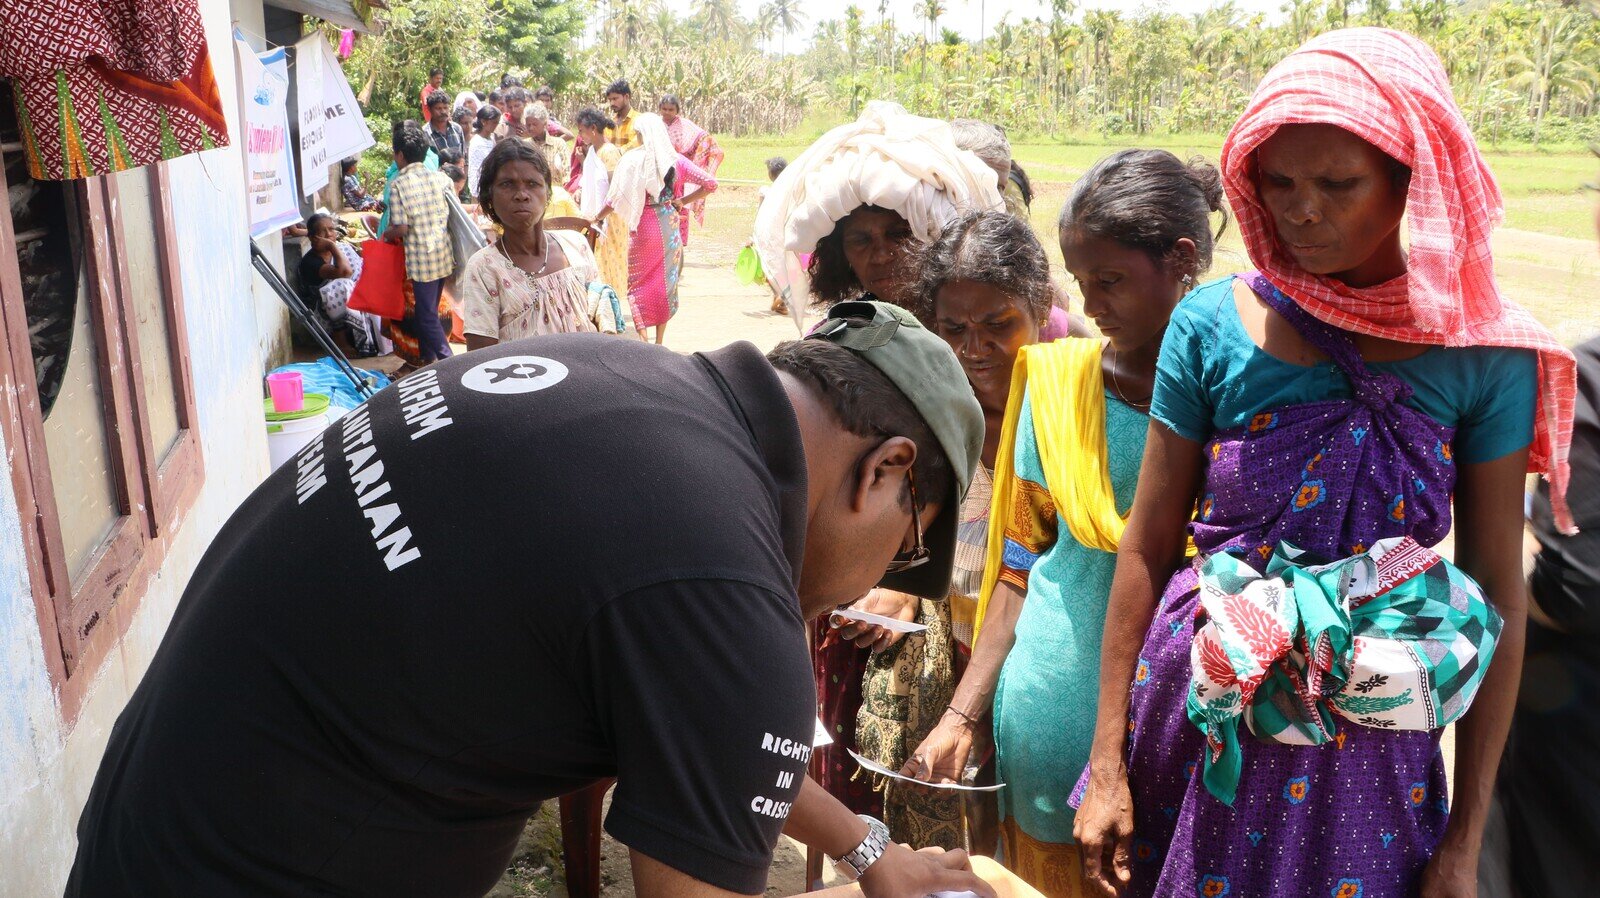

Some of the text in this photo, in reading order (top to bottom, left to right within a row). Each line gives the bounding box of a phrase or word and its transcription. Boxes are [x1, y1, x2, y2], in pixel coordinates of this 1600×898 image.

[397, 370, 453, 440] OXFAM
[296, 433, 327, 504] TEAM
[762, 732, 810, 763] RIGHTS
[776, 771, 794, 788] IN
[751, 796, 792, 819] CRISIS
